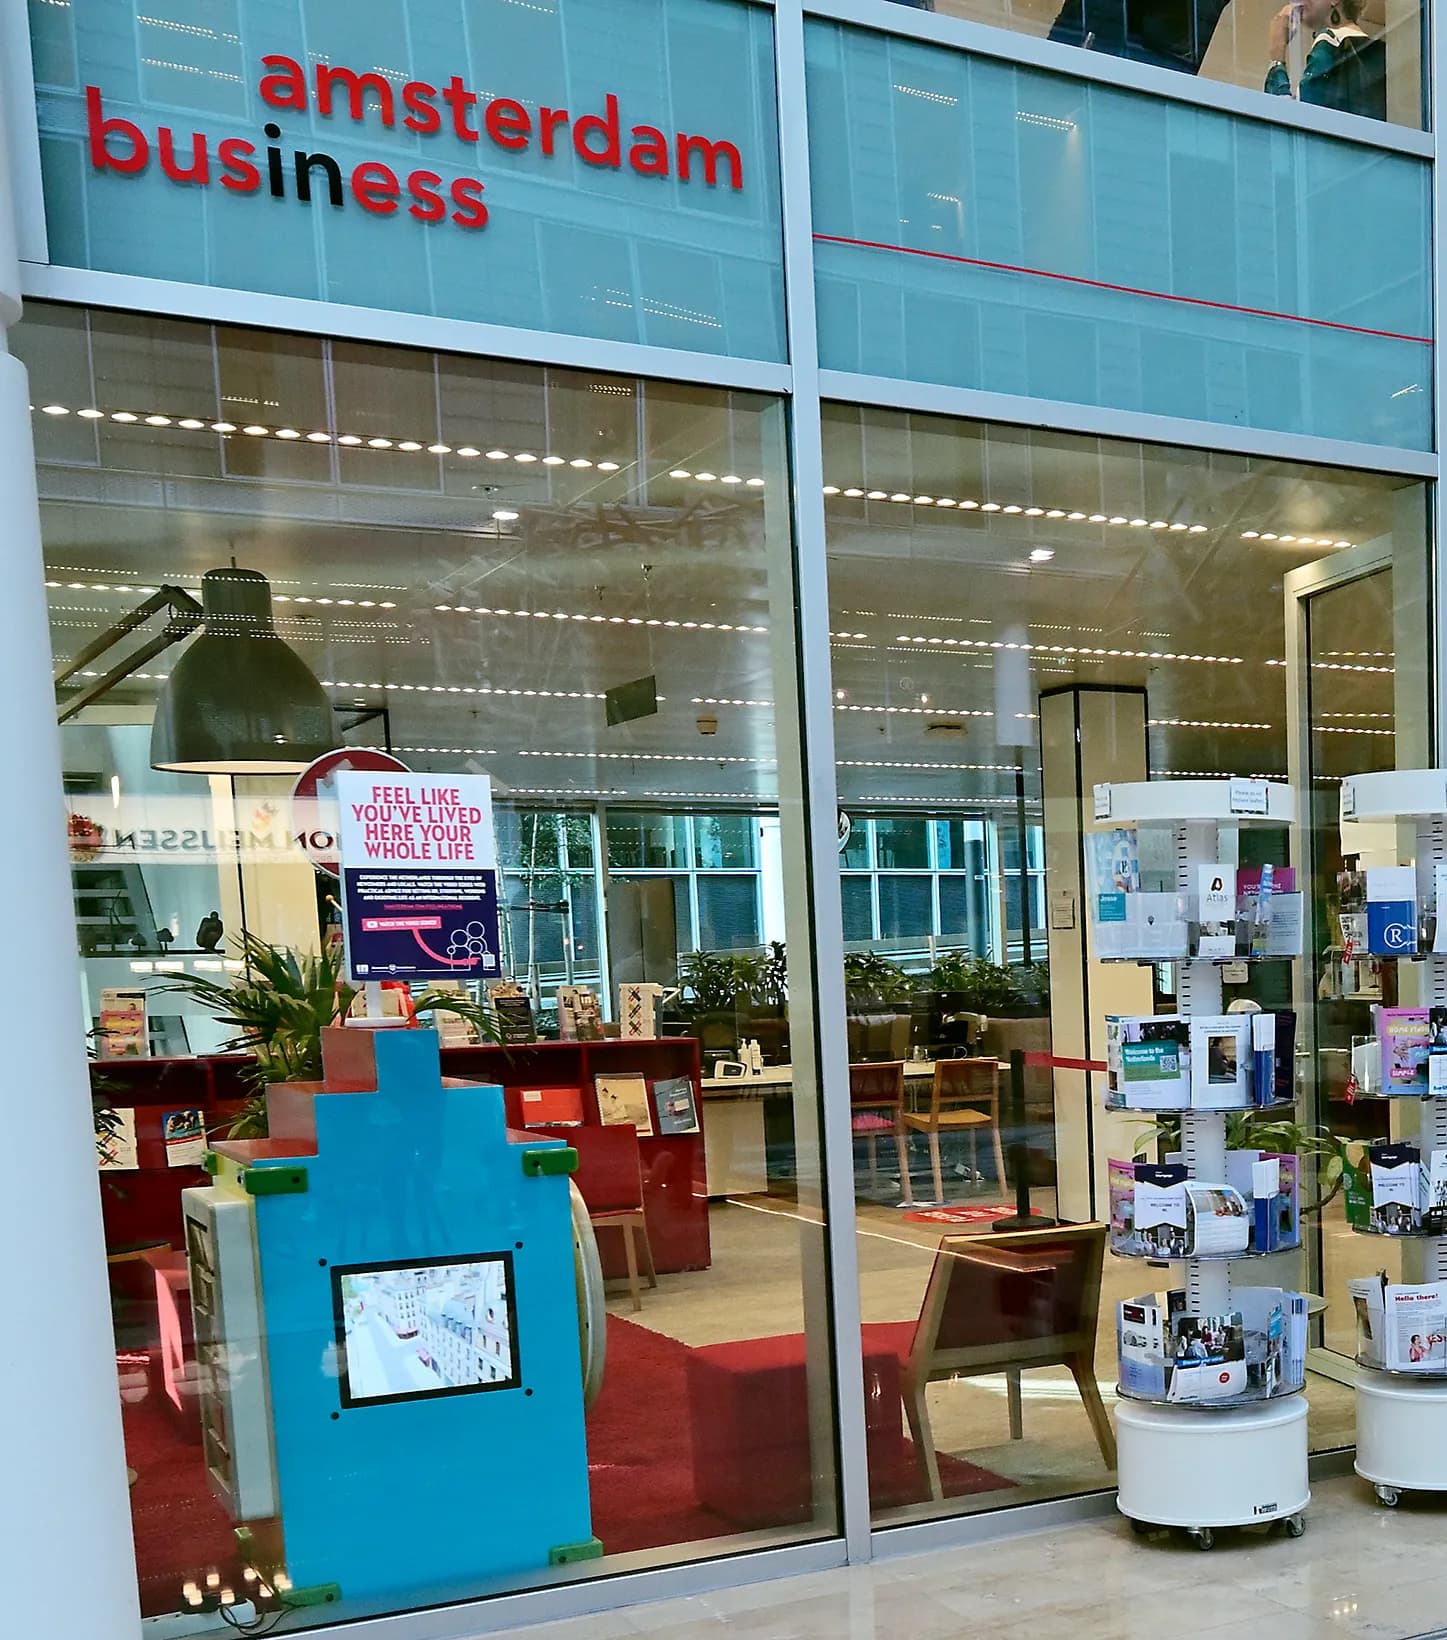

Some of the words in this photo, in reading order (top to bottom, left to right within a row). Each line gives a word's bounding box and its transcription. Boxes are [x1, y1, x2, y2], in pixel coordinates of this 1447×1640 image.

[260, 54, 744, 191] amsterdam
[86, 86, 490, 230] business
[372, 786, 416, 805] FEEL
[421, 788, 461, 806] LIKE
[428, 806, 482, 825] LIVED
[365, 823, 414, 841] HERE
[420, 825, 472, 842] YOUR
[364, 841, 432, 860] WHOLE
[437, 843, 475, 861] LIFE
[1416, 1292, 1439, 1301] there!
